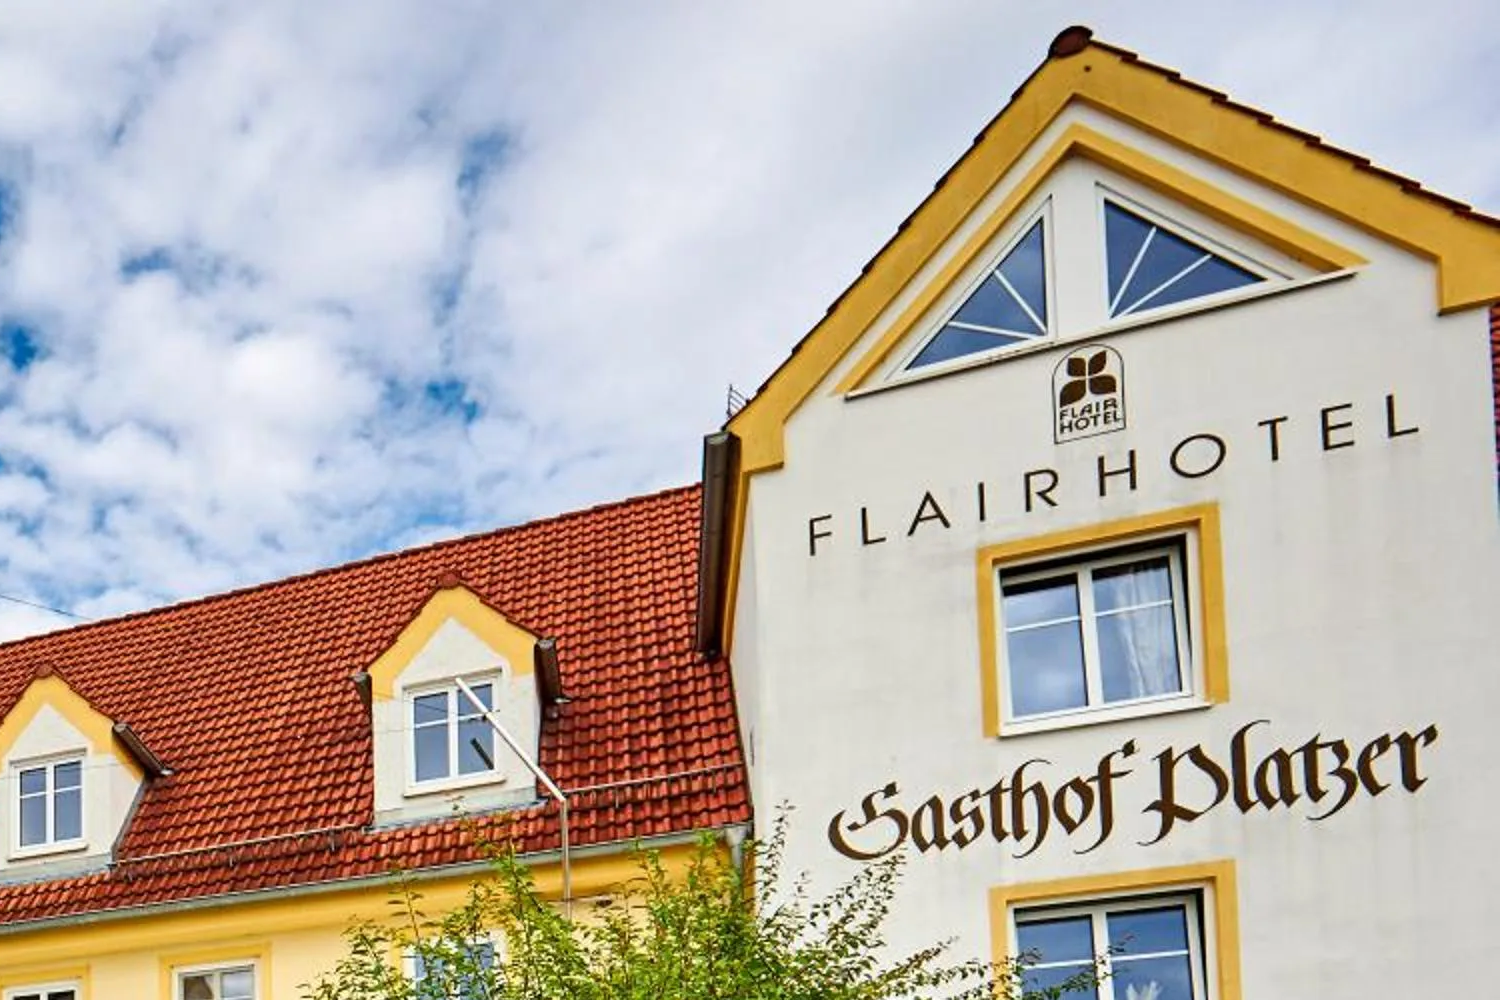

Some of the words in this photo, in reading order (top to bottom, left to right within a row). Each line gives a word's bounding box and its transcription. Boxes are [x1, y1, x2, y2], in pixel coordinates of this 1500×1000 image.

[1059, 397, 1118, 421] FLAIR
[1059, 410, 1123, 434] HOTEL
[808, 394, 1420, 557] FLAIRHOTEL
[827, 738, 1137, 860] Gasthof
[1136, 719, 1439, 848] Platzer
